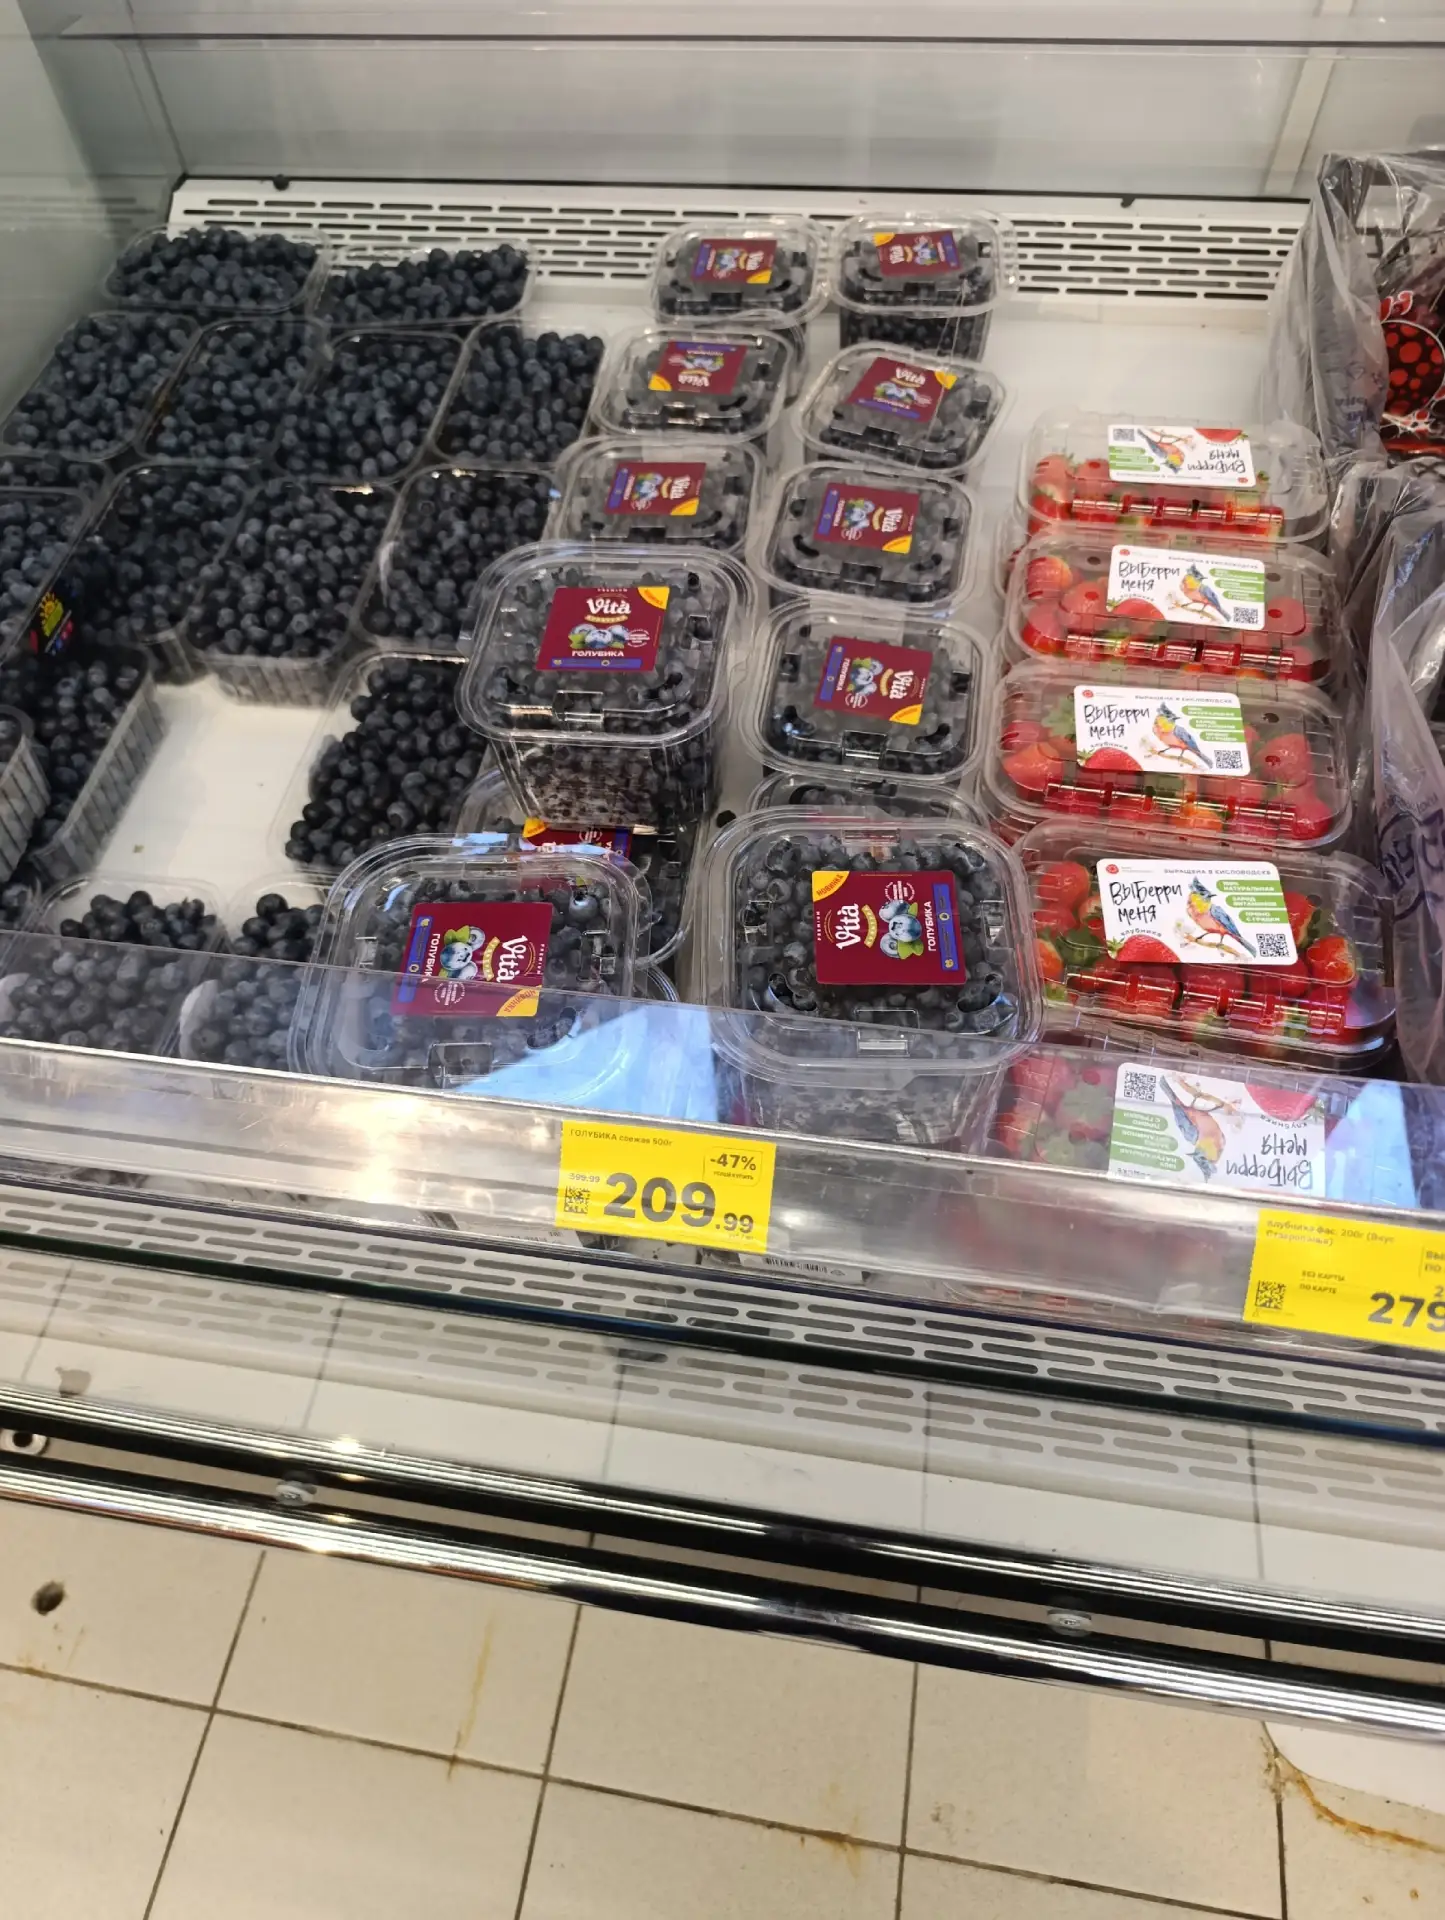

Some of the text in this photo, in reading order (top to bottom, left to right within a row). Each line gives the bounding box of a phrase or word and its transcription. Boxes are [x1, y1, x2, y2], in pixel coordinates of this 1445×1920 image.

[1084, 703, 1150, 725] ВыБерри
[1089, 724, 1125, 741] меня
[816, 873, 844, 897] НОВИНКА
[1109, 881, 1183, 906] ВыБерри
[1117, 904, 1156, 926] меня
[923, 901, 936, 952] ГОЛУБИКА
[570, 1128, 673, 1147] ГОЛУБИКА свежая 500г
[1261, 1133, 1308, 1157] меня
[710, 1153, 757, 1171] -47%
[1225, 1153, 1314, 1190] ВыБерри
[1317, 1272, 1346, 1282] КАРТЫ
[1311, 1285, 1338, 1295] КАРТЕ
[1367, 1291, 1445, 1333] 279
